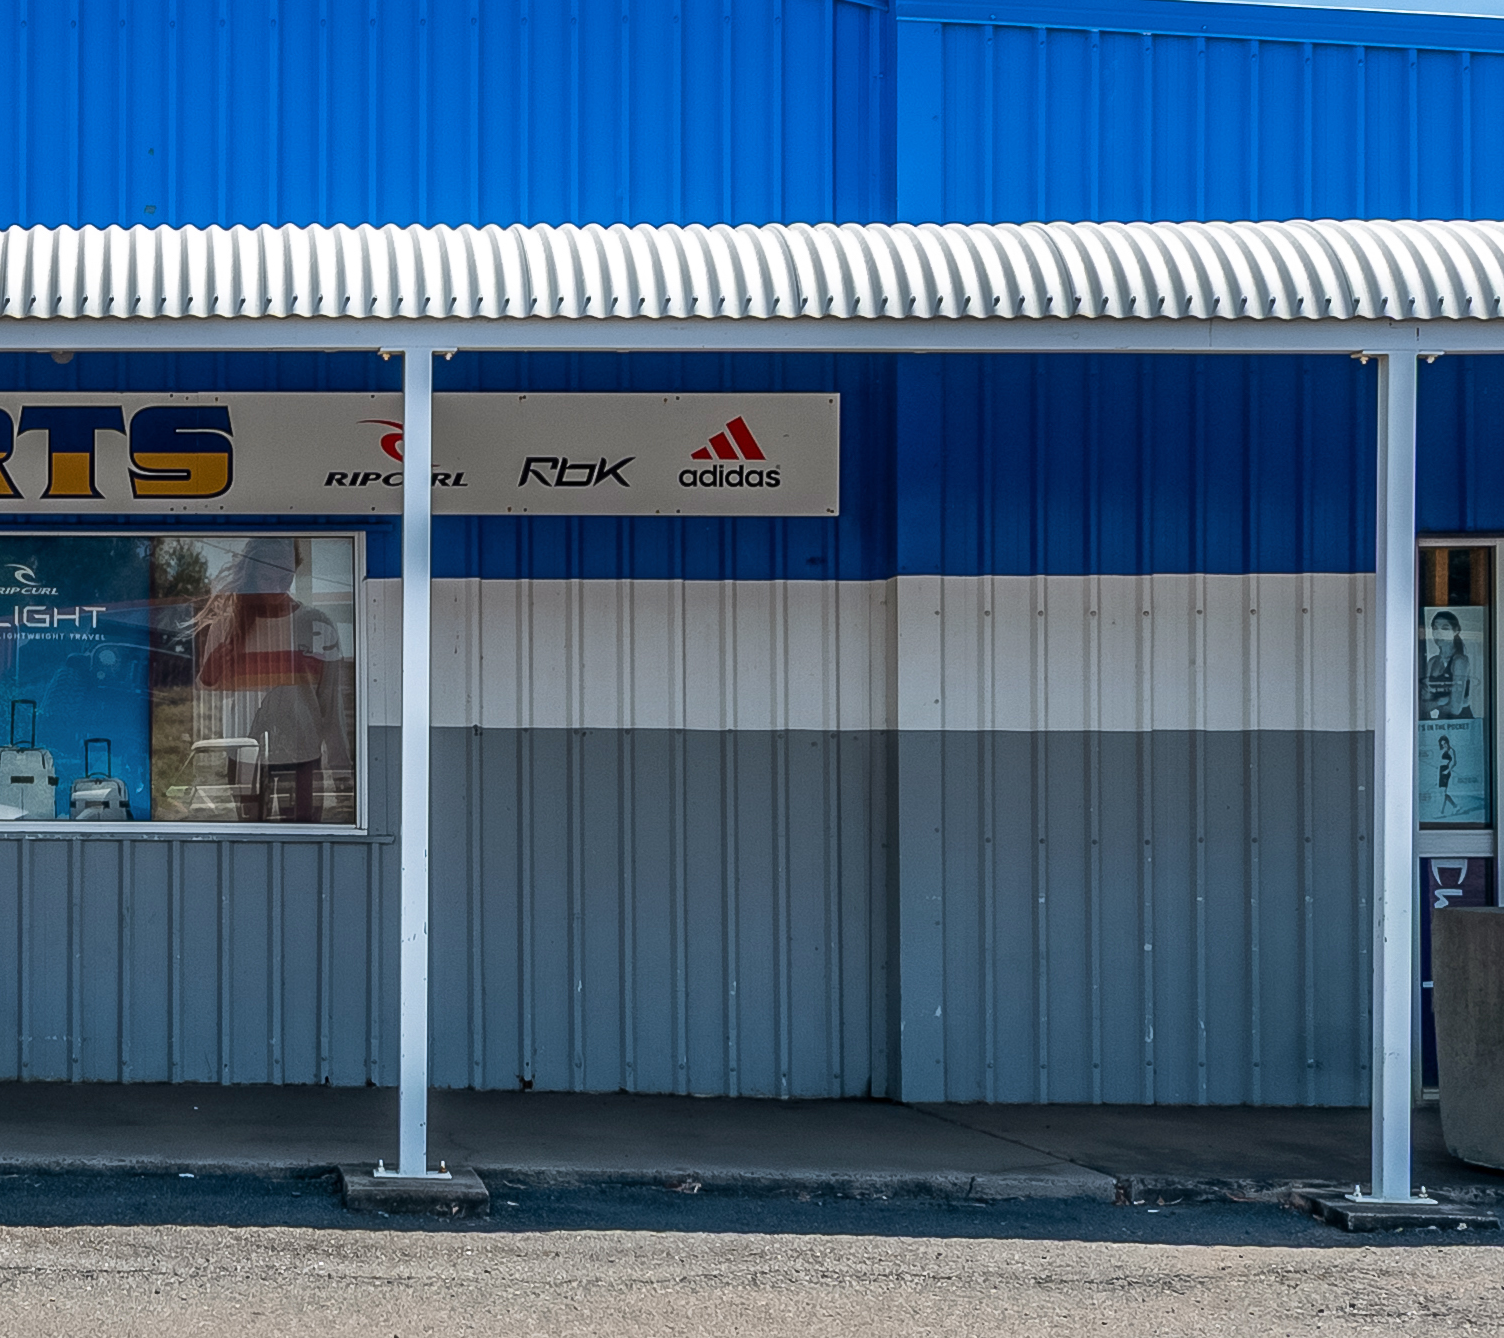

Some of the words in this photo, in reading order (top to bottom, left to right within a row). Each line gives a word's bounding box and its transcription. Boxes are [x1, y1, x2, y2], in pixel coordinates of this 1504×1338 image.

[678, 463, 781, 489] adidas
[20, 587, 59, 595] CURL
[69, 633, 106, 641] TRAVEL
